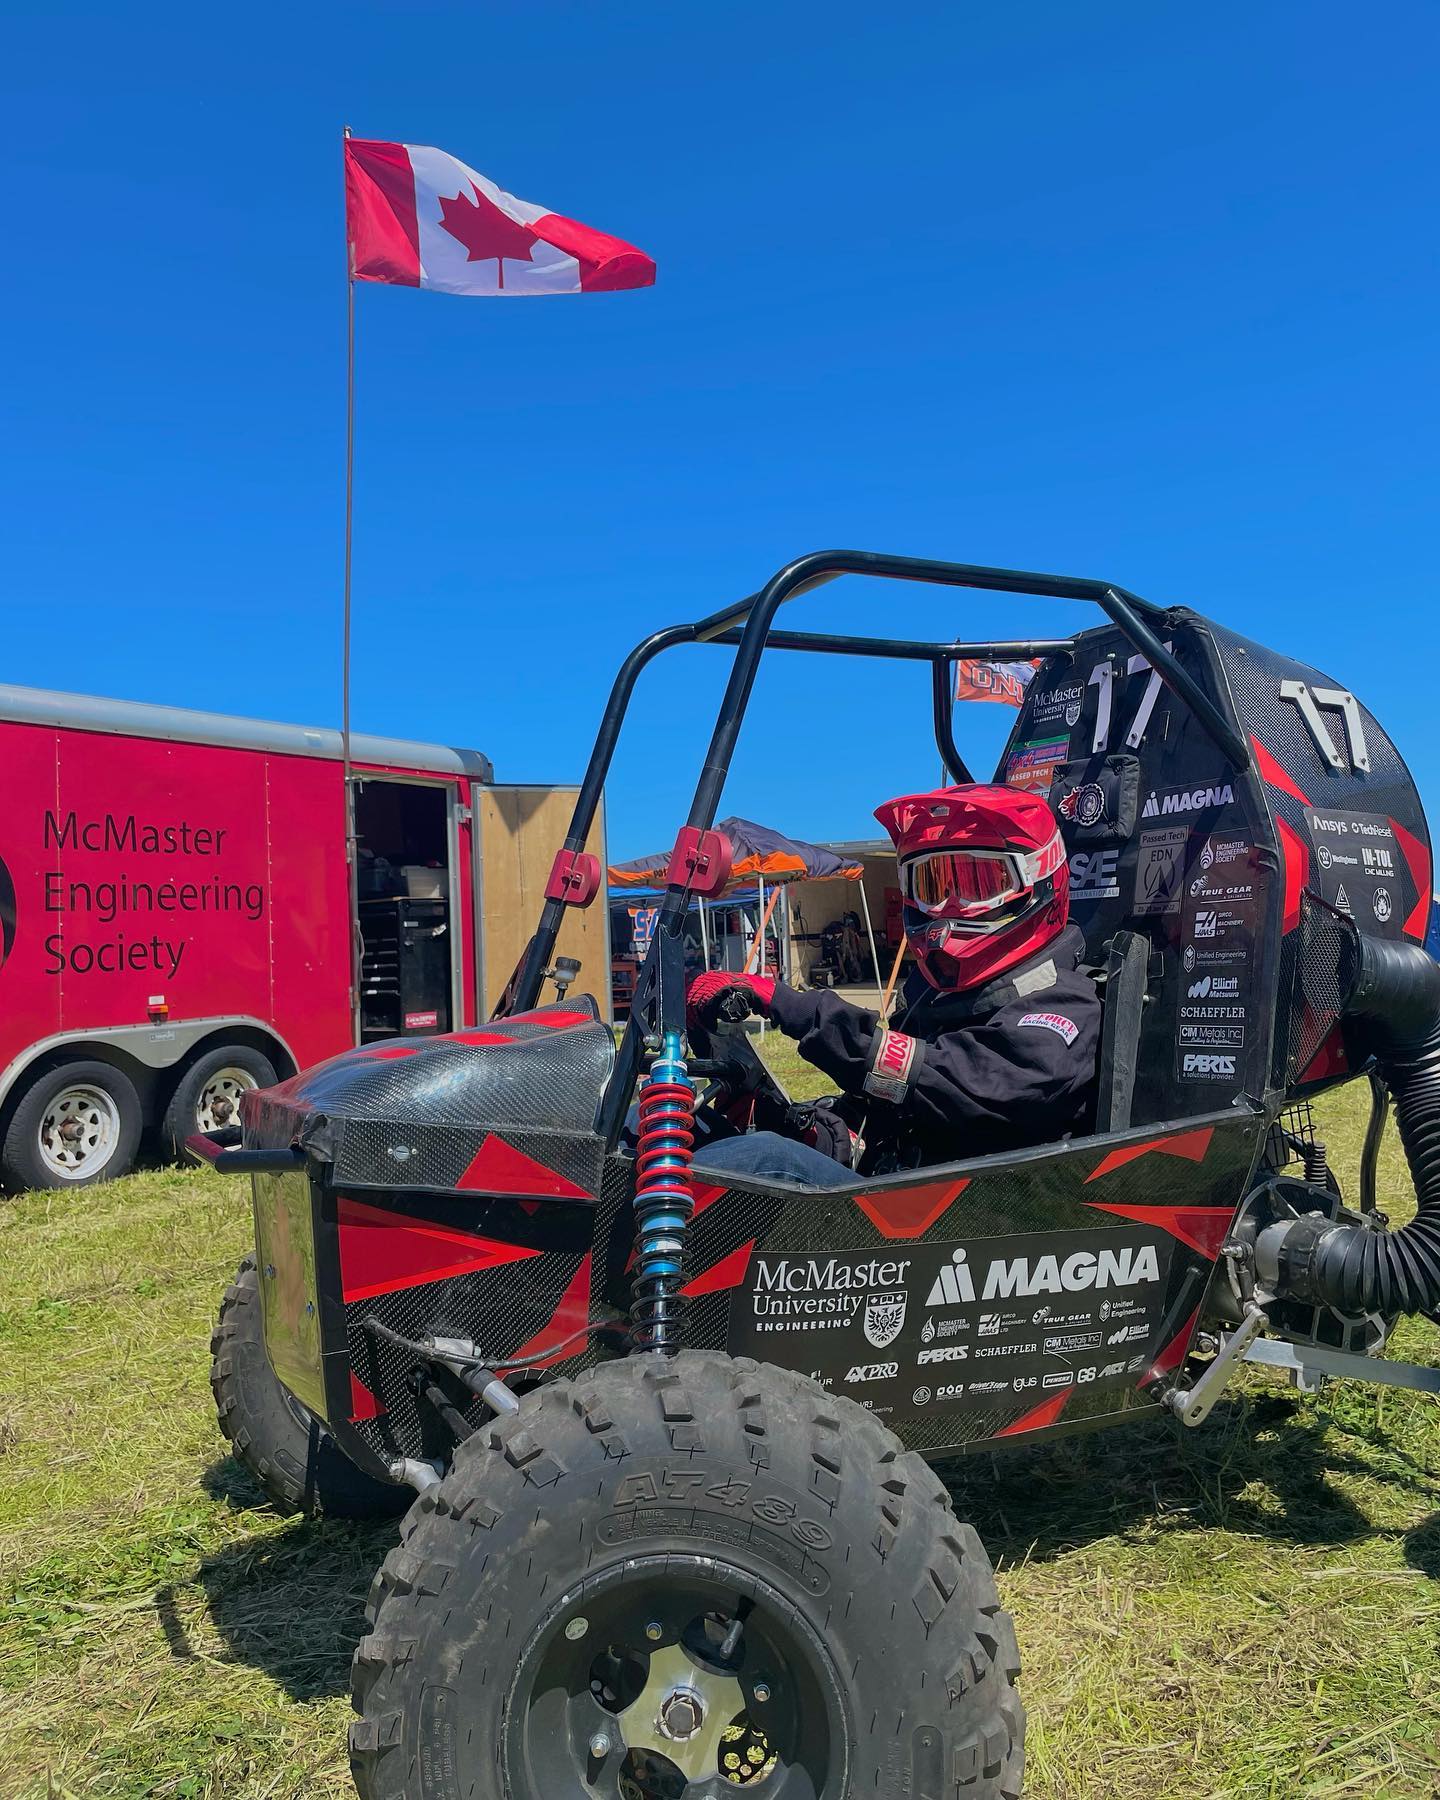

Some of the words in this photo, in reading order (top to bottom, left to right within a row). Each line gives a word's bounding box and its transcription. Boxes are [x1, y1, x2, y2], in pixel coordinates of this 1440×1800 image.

[1034, 686, 1082, 707] McMaster
[1033, 702, 1066, 717] University
[1280, 680, 1370, 773] 17
[1032, 768, 1049, 778] TECH
[1161, 785, 1235, 814] MAGNA
[43, 810, 228, 855] McMaster
[1313, 815, 1348, 836] Ansys
[1142, 833, 1166, 843] Passed
[1168, 831, 1185, 841] Tech
[1151, 848, 1173, 862] EDN
[1215, 855, 1236, 863] SOCIETY
[1361, 848, 1393, 867] IN-TOL
[1070, 850, 1119, 888] SAE
[44, 872, 264, 922] Engineering
[1201, 888, 1223, 896] TRUE
[1226, 885, 1252, 894] GEAR
[44, 933, 186, 980] Society
[1197, 950, 1215, 959] Unified
[1215, 950, 1247, 960] Engineering
[1181, 1007, 1245, 1018] SCHAEFFLER
[1050, 1022, 1069, 1038] GEAR
[1181, 1027, 1197, 1037] CIM
[1200, 1027, 1226, 1038] Metals
[753, 1259, 911, 1292] McMaster
[981, 1246, 1160, 1300] MAGNA
[752, 1293, 863, 1315] University
[1111, 1306, 1146, 1317] Engineering
[1112, 1300, 1134, 1309] Unified
[756, 1318, 851, 1331] ENGINEERING
[1068, 1313, 1092, 1321] GEAR
[1045, 1338, 1061, 1347] CIM
[975, 1343, 1037, 1358] SCHAEFFLER
